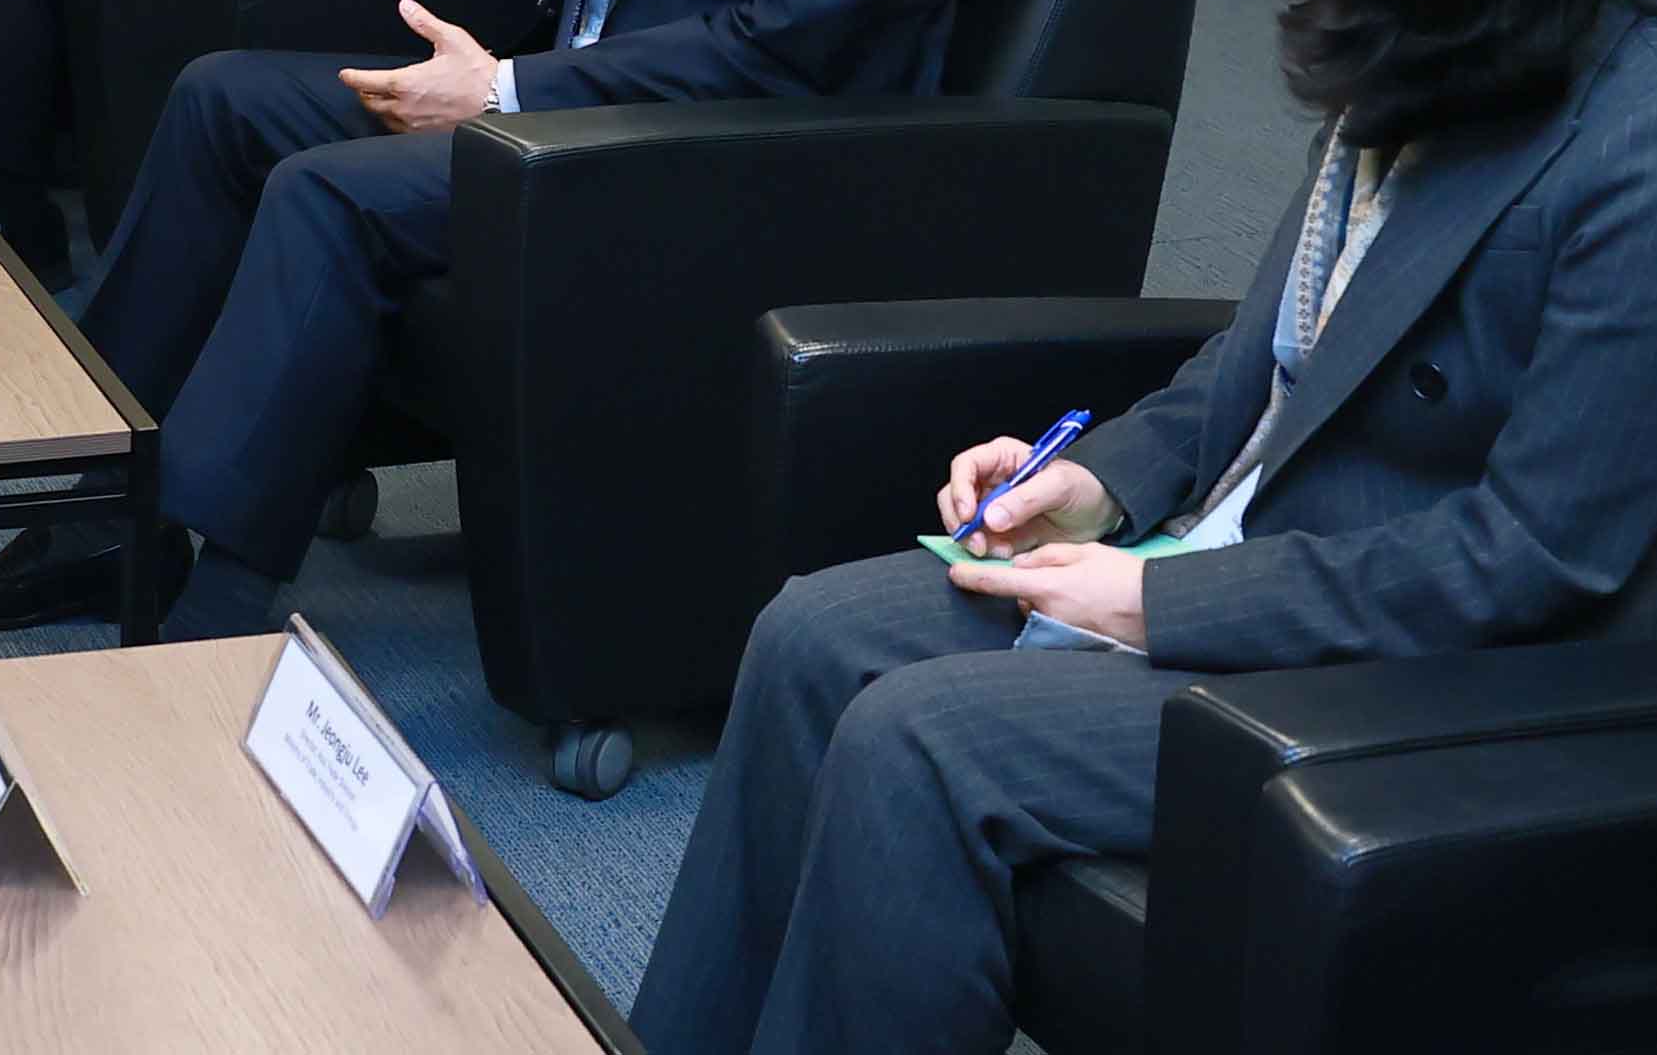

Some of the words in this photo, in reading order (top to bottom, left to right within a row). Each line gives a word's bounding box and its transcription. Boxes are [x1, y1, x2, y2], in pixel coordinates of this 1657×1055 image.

[306, 700, 321, 728] Mr.
[320, 720, 352, 767] Jeongju
[352, 757, 369, 786] Lee
